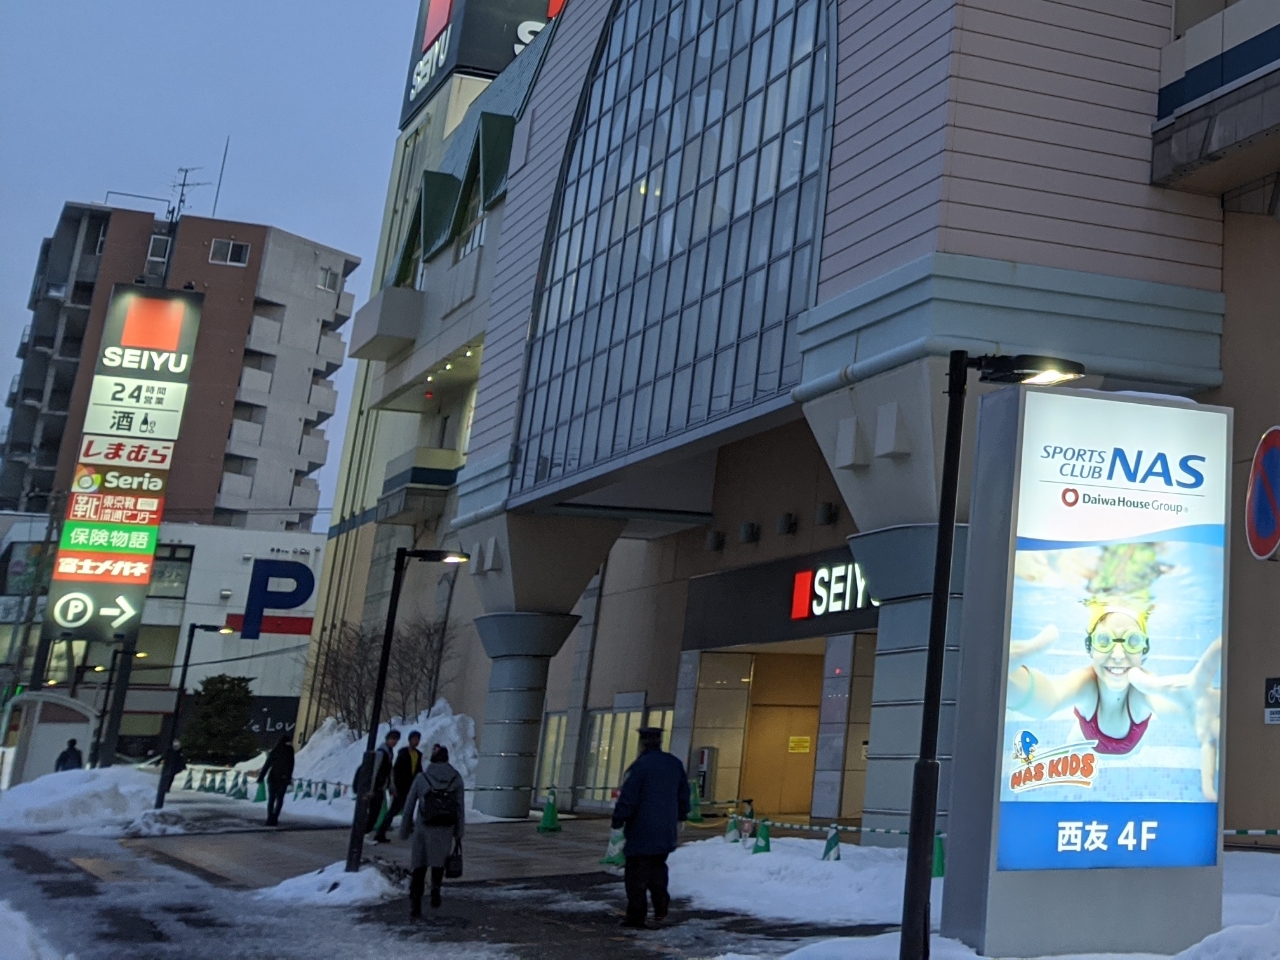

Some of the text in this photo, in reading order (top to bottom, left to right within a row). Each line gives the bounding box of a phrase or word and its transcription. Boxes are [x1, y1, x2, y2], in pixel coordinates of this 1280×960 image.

[102, 346, 189, 373] SEIYU
[109, 410, 135, 432] 酒
[82, 440, 171, 464] しまむら
[1040, 445, 1206, 489] SPORTS NAS
[1059, 462, 1103, 479] CLUB
[104, 471, 163, 491] Seria
[70, 527, 149, 549] 保険物語
[241, 559, 315, 640] P
[812, 562, 880, 616] SEIY
[265, 717, 296, 732] Lov
[1010, 753, 1095, 790] NAS KIDS
[1057, 820, 1158, 852] 西友 4F
